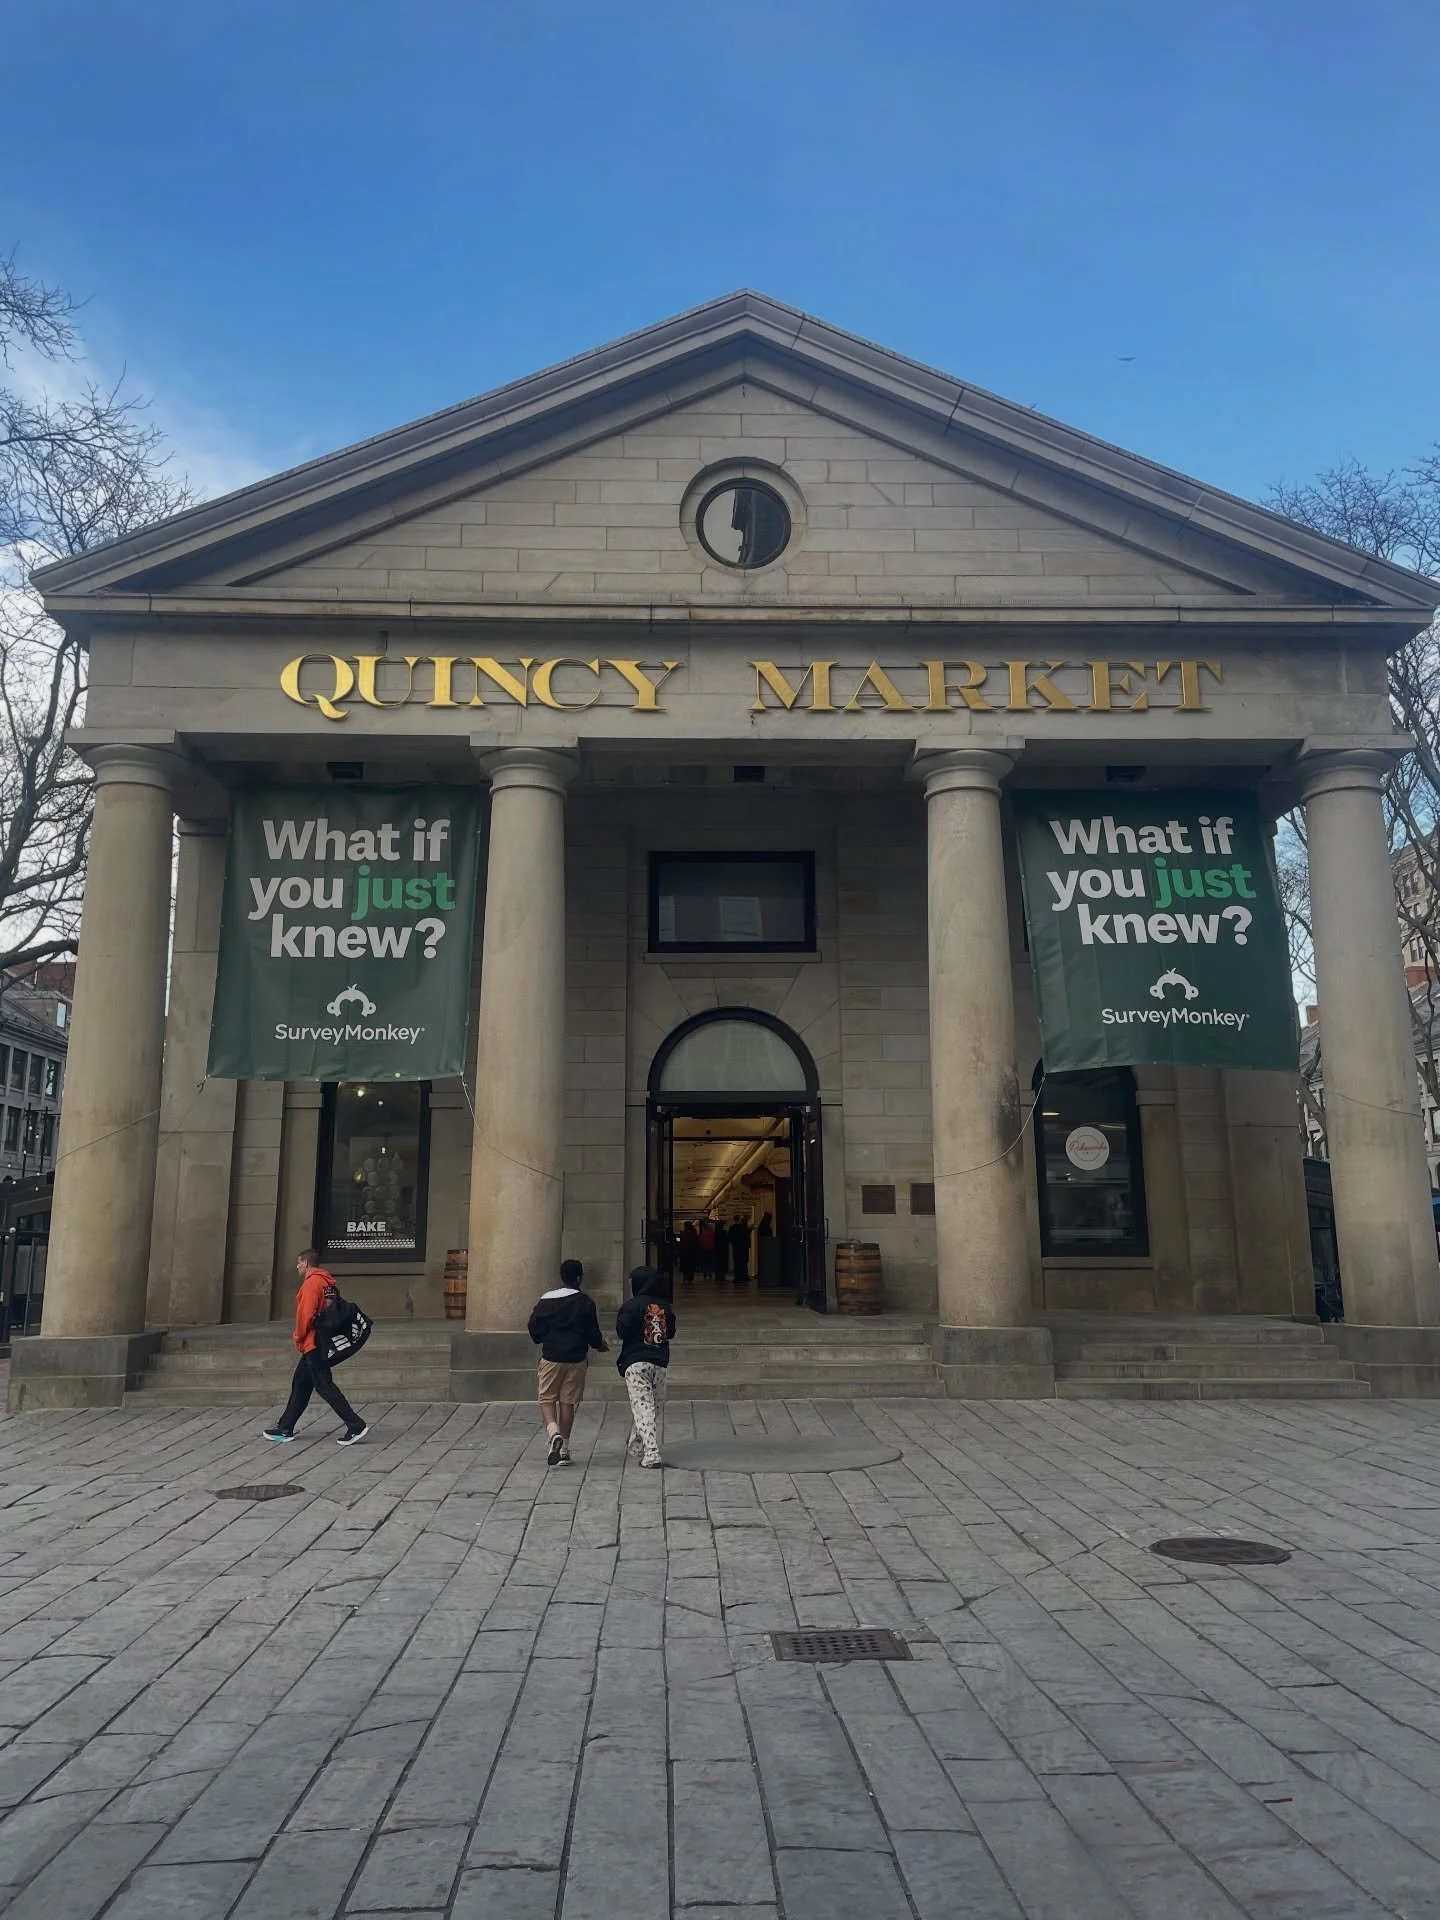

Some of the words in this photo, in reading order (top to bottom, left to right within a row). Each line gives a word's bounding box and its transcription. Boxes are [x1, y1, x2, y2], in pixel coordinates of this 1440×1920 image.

[280, 654, 681, 720] QUINCY
[748, 660, 1223, 712] MARKET
[263, 818, 400, 861] What
[413, 818, 450, 861] if
[1049, 816, 1192, 854] What
[1199, 816, 1234, 854] if
[248, 876, 343, 920] you
[351, 865, 455, 920] just
[1047, 868, 1146, 911] you
[1154, 857, 1257, 908] just
[270, 914, 446, 959] knew?
[1077, 904, 1253, 945] knew?
[275, 1023, 422, 1045] SurveyMonkey
[1102, 1007, 1246, 1031] SurveyMonkey
[346, 1221, 387, 1232] BAKE
